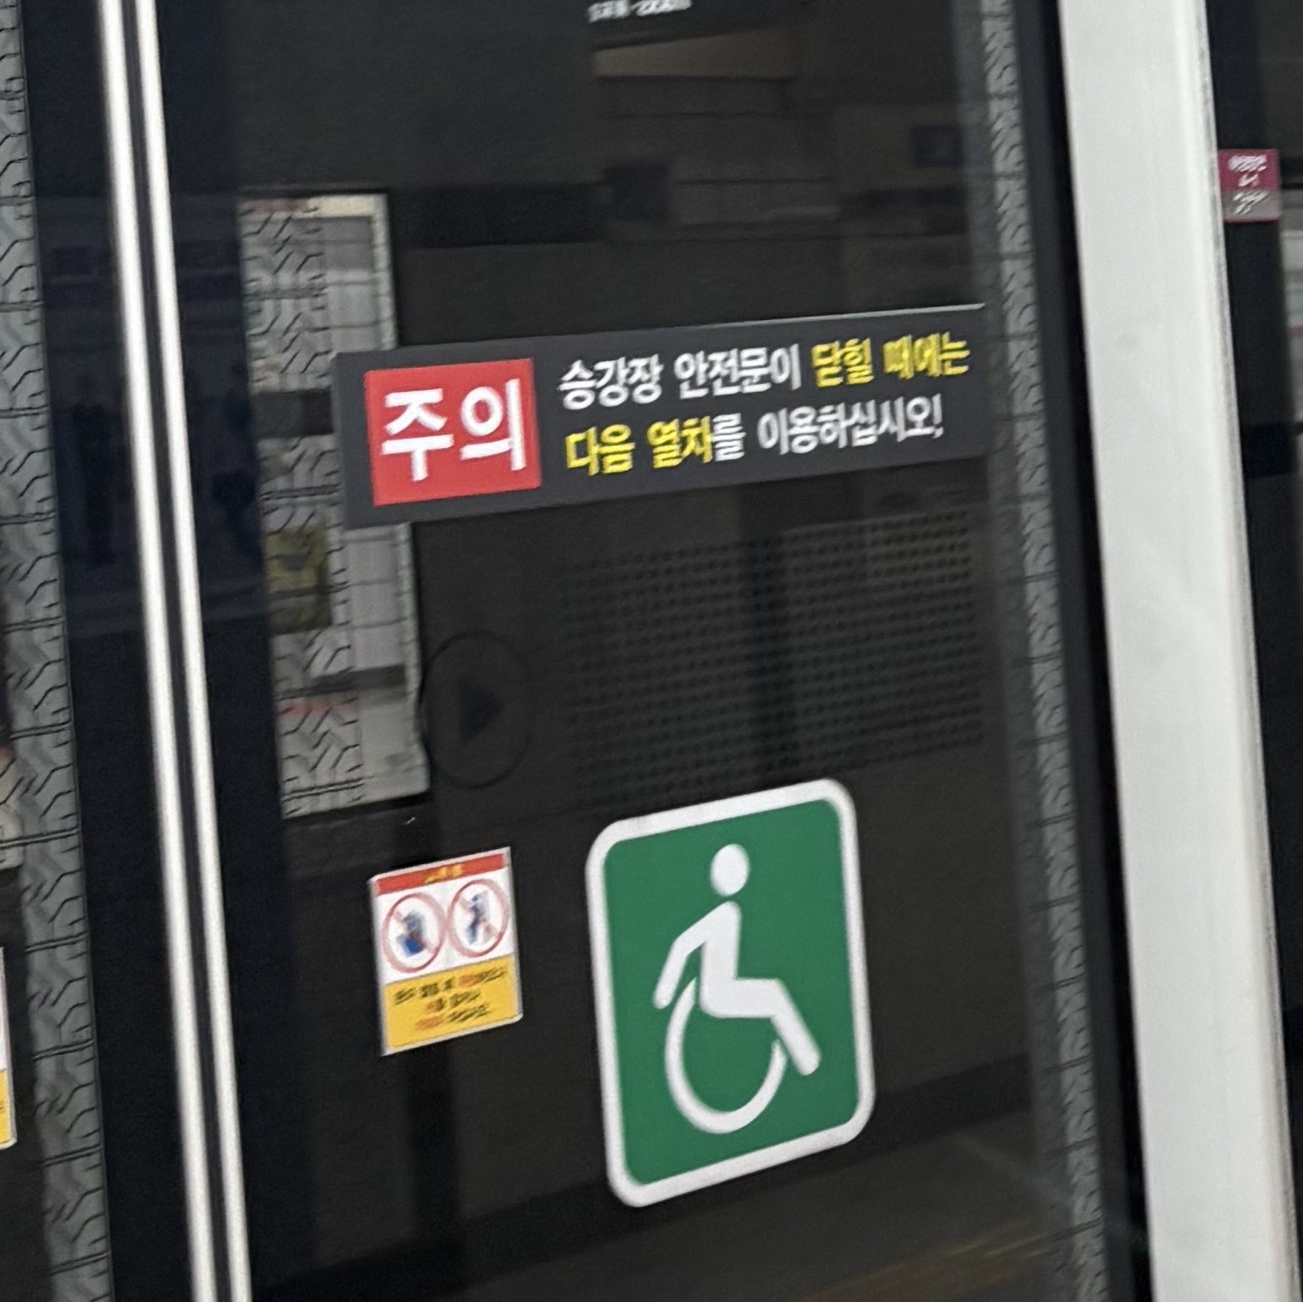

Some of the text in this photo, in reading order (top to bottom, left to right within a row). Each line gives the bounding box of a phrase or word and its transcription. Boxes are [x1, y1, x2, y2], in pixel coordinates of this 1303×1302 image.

[558, 333, 971, 412] 승강장 안전문이 닫힐 때에는
[381, 378, 527, 482] 주의
[564, 425, 635, 477] 다음
[646, 411, 746, 473] 열차를
